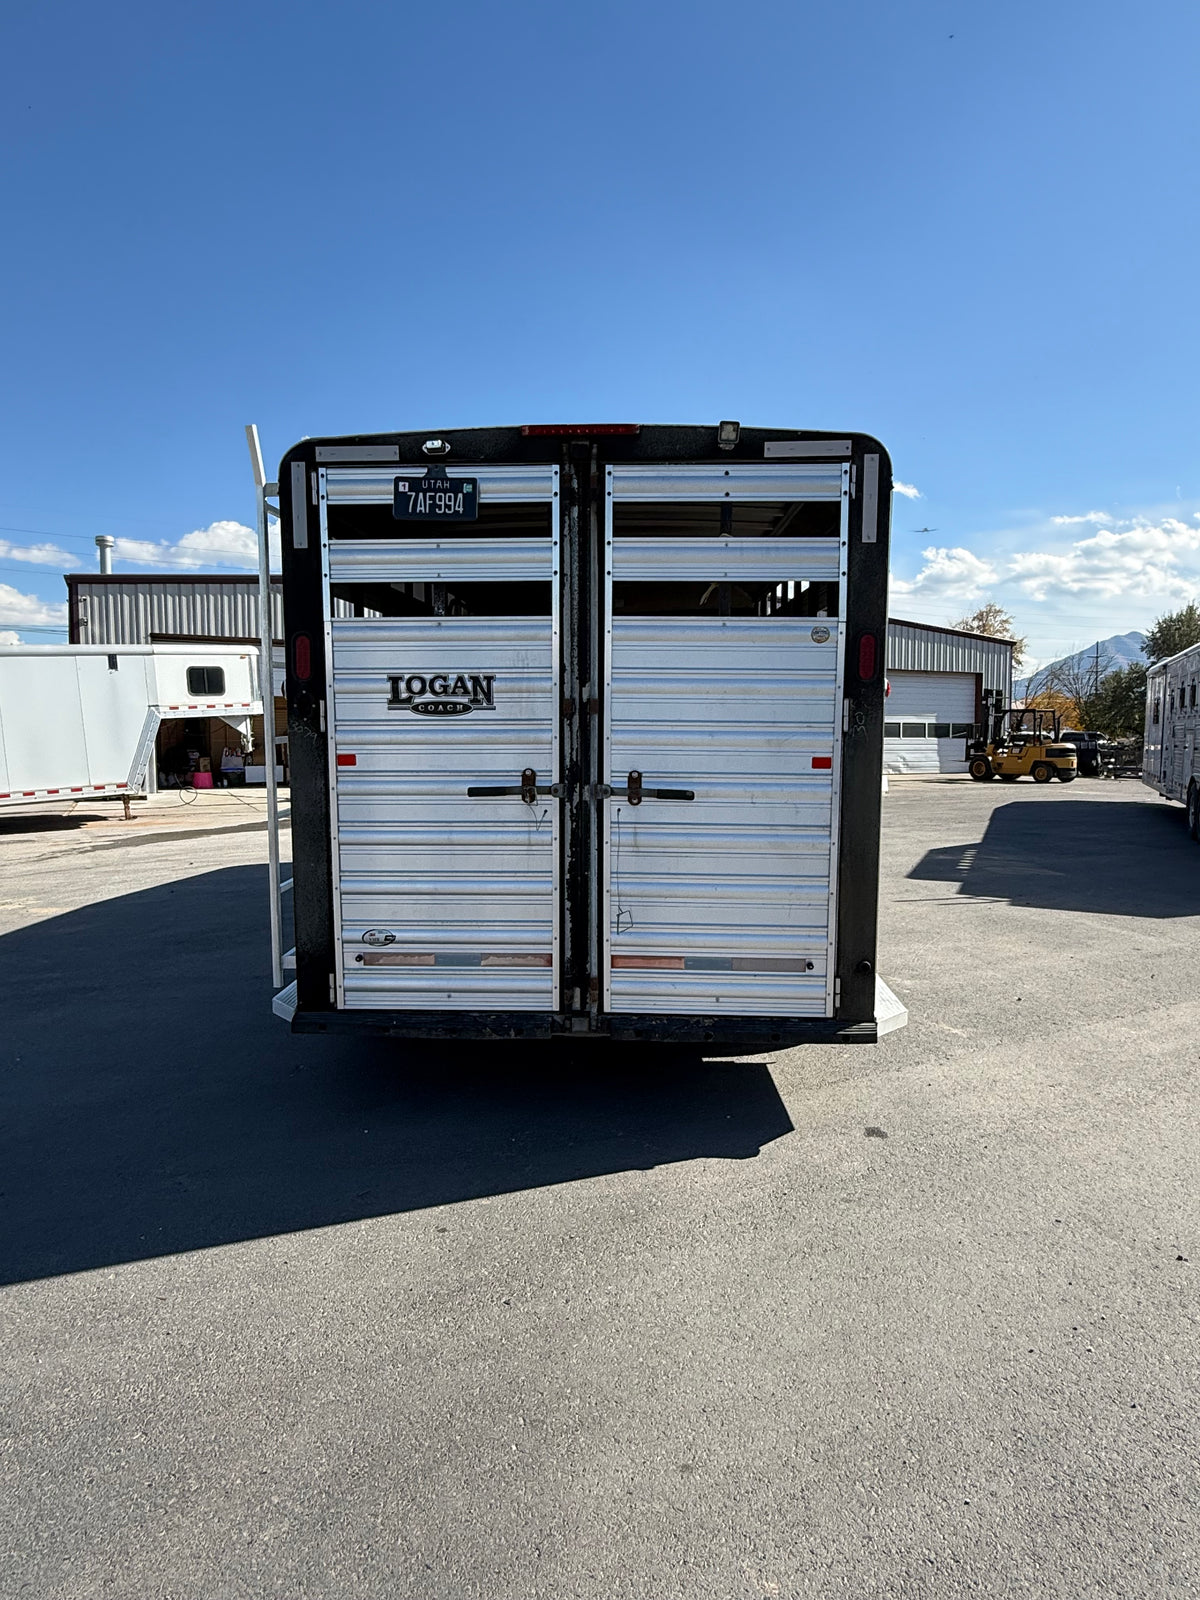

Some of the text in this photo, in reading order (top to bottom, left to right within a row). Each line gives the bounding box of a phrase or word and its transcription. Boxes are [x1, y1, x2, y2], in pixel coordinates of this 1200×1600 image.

[422, 480, 450, 489] UTAH
[407, 492, 464, 513] 7AF994
[387, 674, 496, 705] LOGAN
[418, 704, 464, 712] COACH
